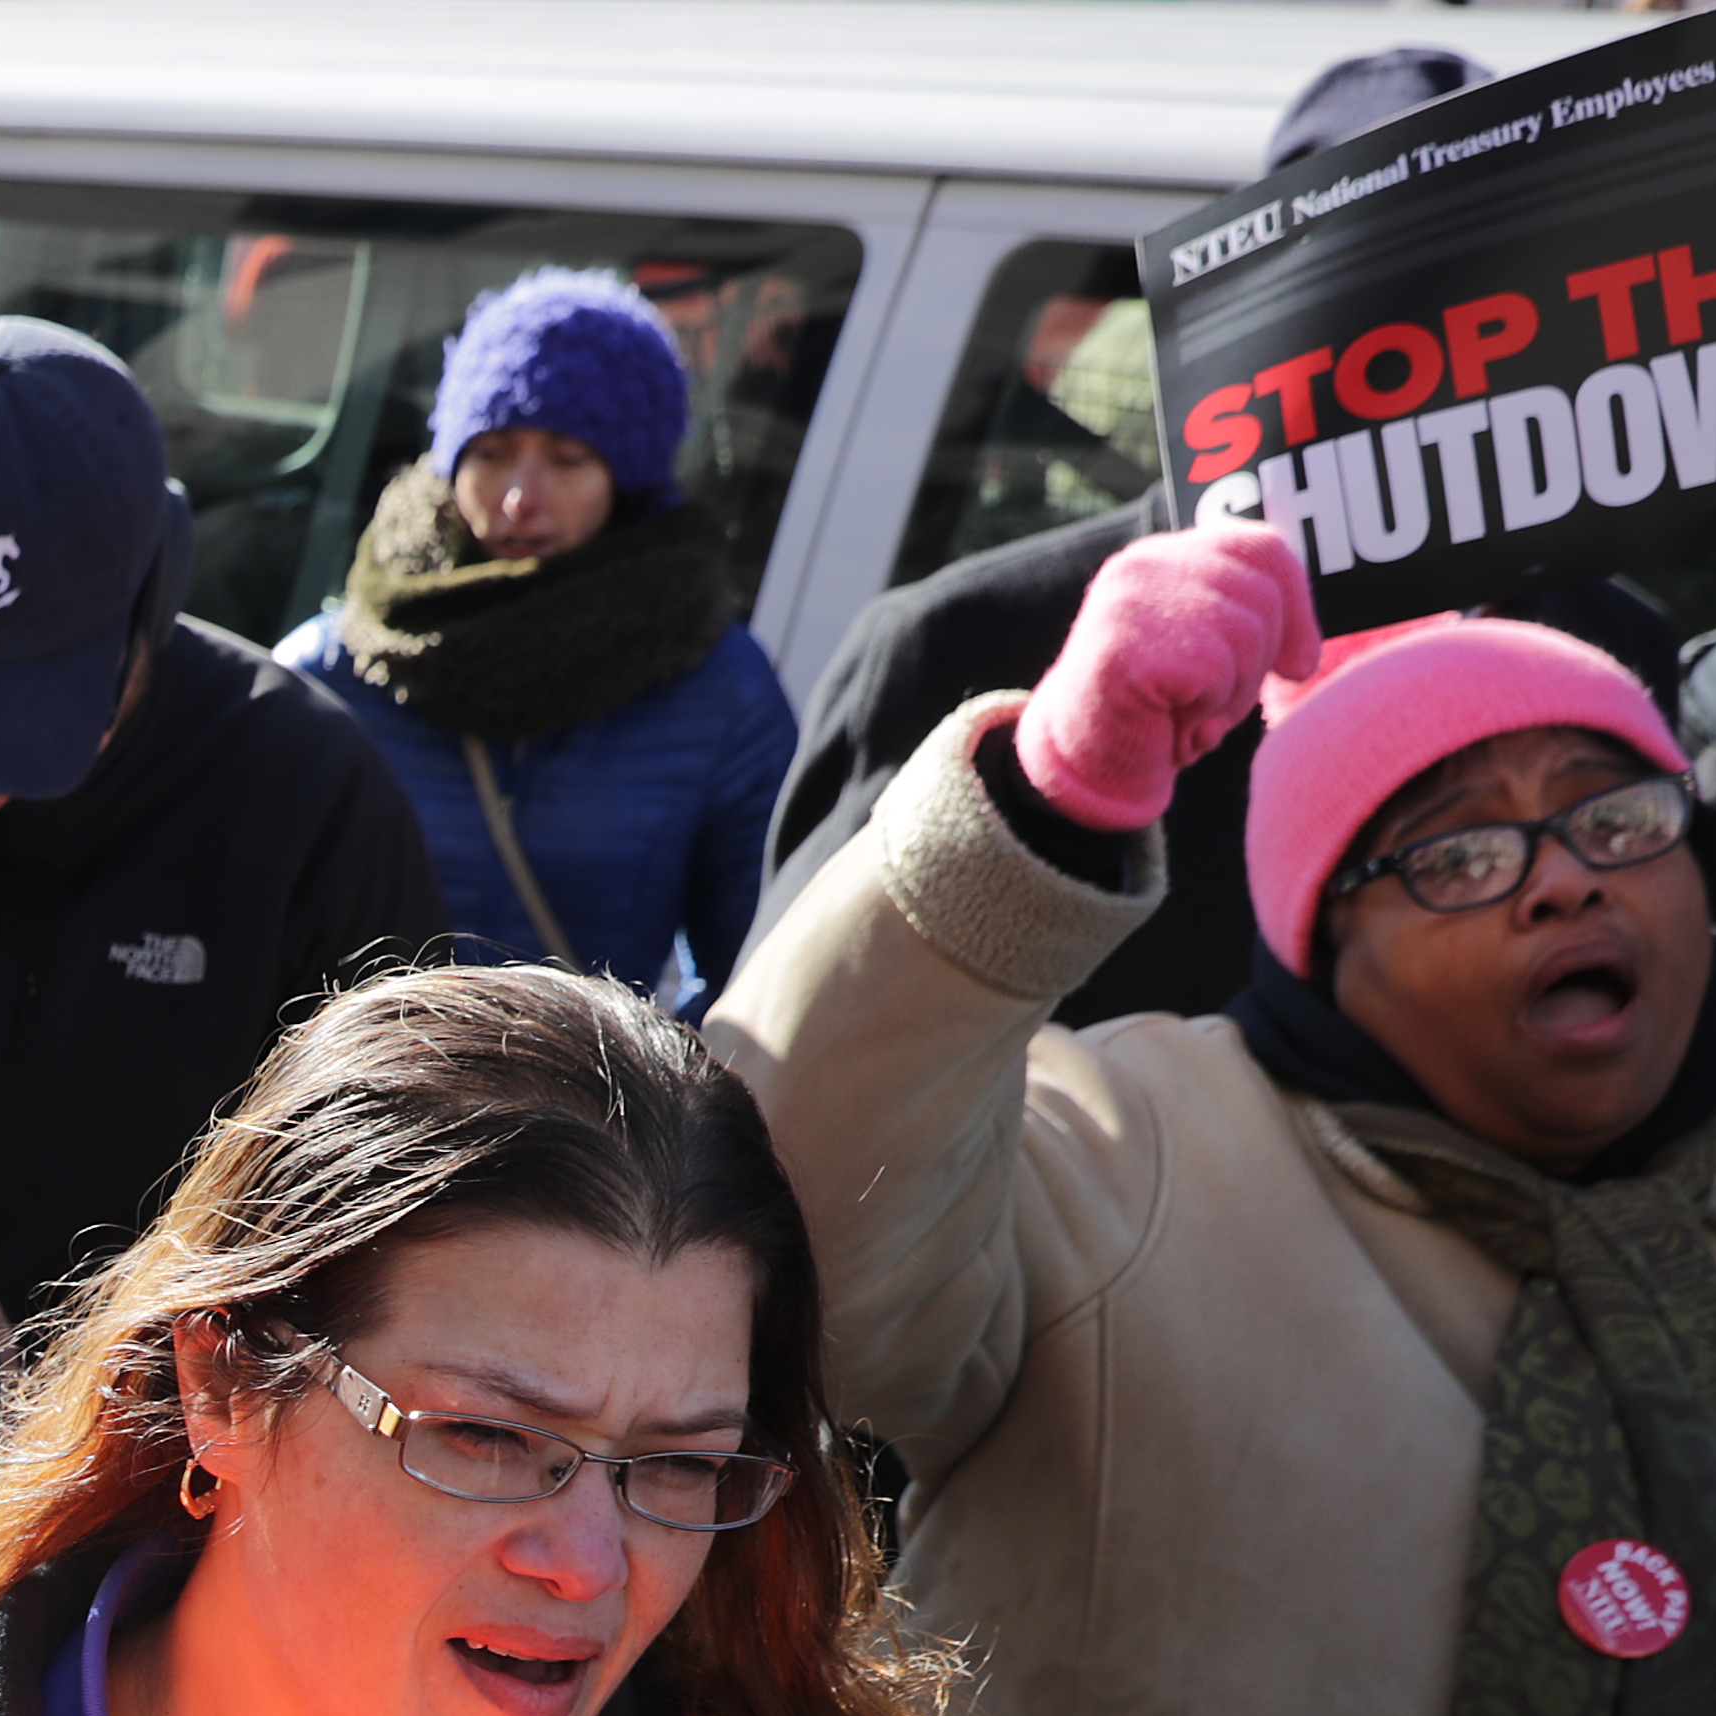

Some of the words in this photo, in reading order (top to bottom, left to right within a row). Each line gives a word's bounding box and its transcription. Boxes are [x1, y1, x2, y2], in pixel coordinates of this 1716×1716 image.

[1169, 200, 1287, 286] NTEU
[1290, 155, 1411, 226] National
[1411, 110, 1545, 174] Treasury
[1183, 291, 1541, 484] STOP
